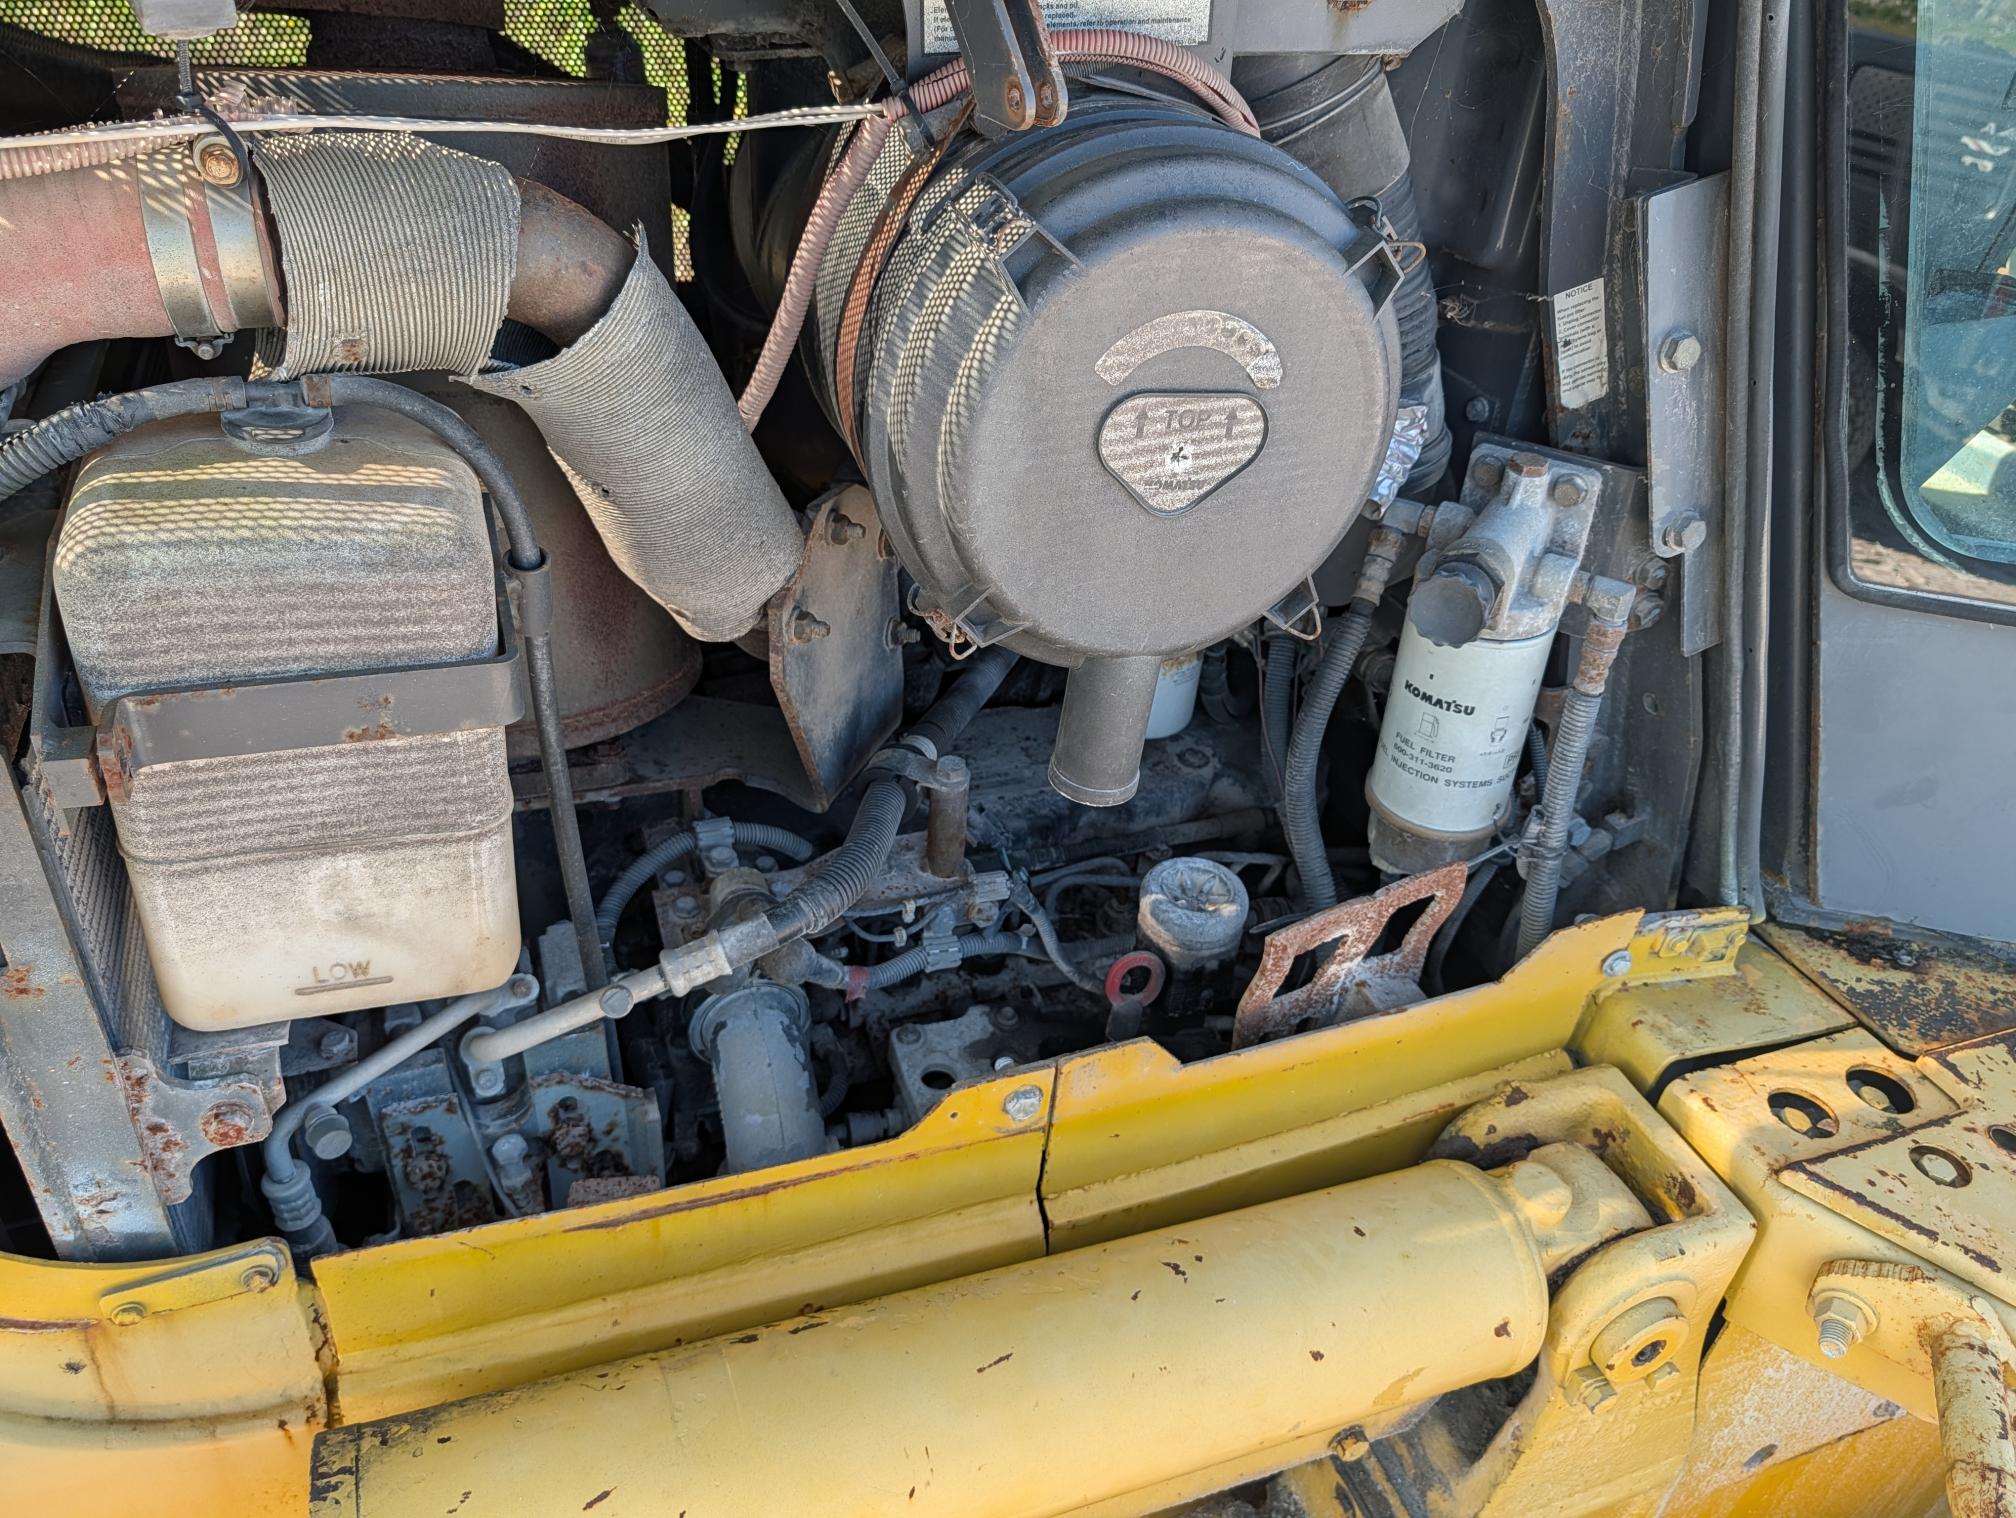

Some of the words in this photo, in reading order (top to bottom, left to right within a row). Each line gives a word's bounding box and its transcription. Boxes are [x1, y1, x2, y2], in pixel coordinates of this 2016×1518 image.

[1080, 19, 1096, 27] refer
[1105, 17, 1137, 27] operation
[1137, 17, 1150, 25] and
[1565, 283, 1593, 299] NOTICE
[1165, 409, 1212, 430] TOP
[1144, 478, 1207, 490] OMATSU
[1404, 680, 1476, 716] KOMATSU
[1393, 742, 1453, 774] 600-311-3620
[1395, 731, 1416, 750] FUEL
[1419, 746, 1456, 763] FILTER
[1390, 754, 1439, 784] INJECTION
[1444, 778, 1493, 789] SYSTEMS
[312, 960, 371, 984] LOW
